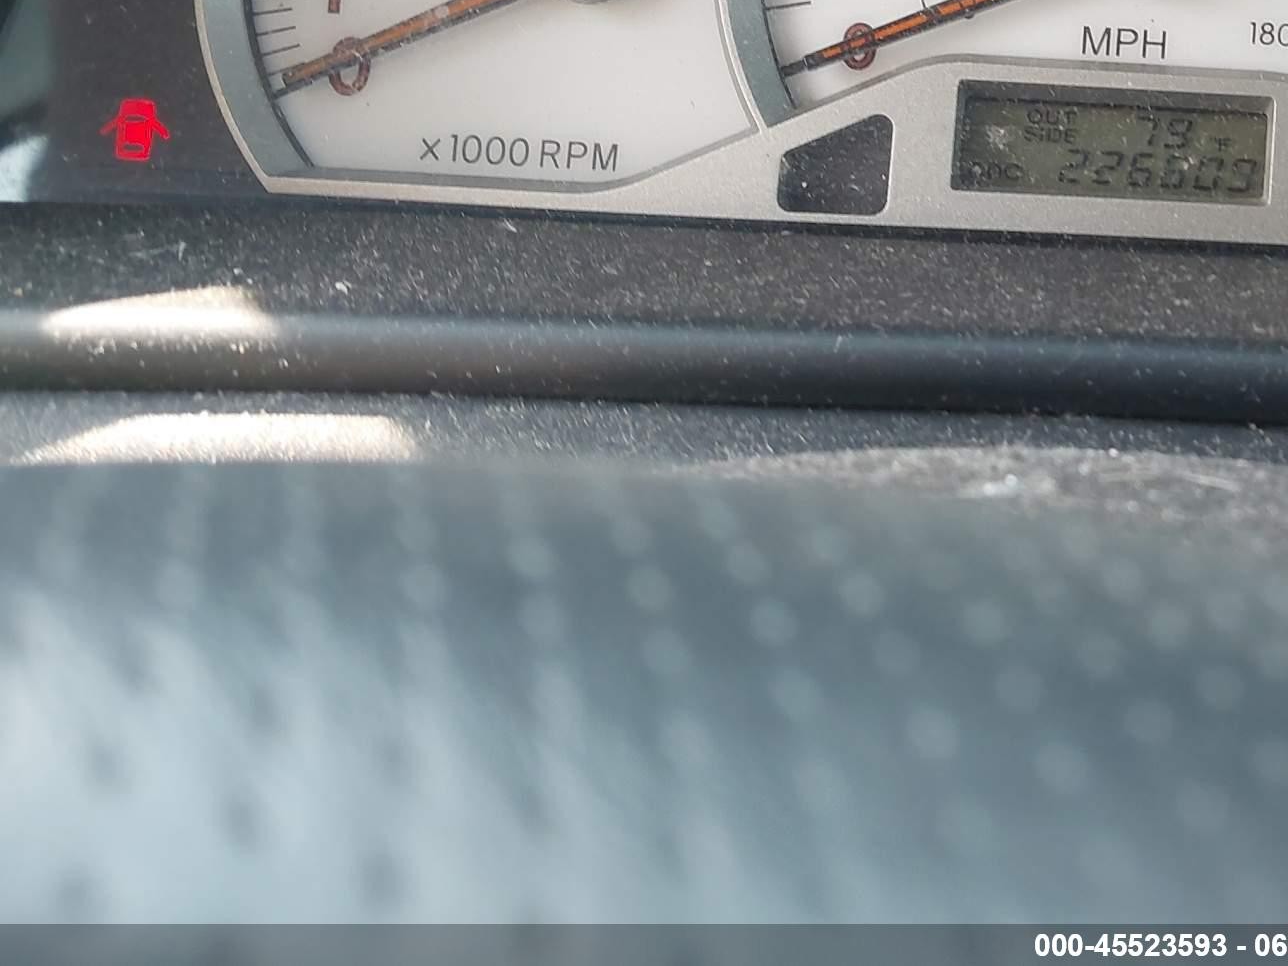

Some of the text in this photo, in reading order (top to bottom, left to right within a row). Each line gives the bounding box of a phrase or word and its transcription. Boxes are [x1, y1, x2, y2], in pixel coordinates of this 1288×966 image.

[844, 22, 876, 70] 0
[1082, 26, 1166, 59] MPH
[329, 37, 371, 96] 0
[1026, 108, 1078, 126] OUT
[1024, 127, 1078, 145] SIDE
[539, 139, 618, 172] RPM
